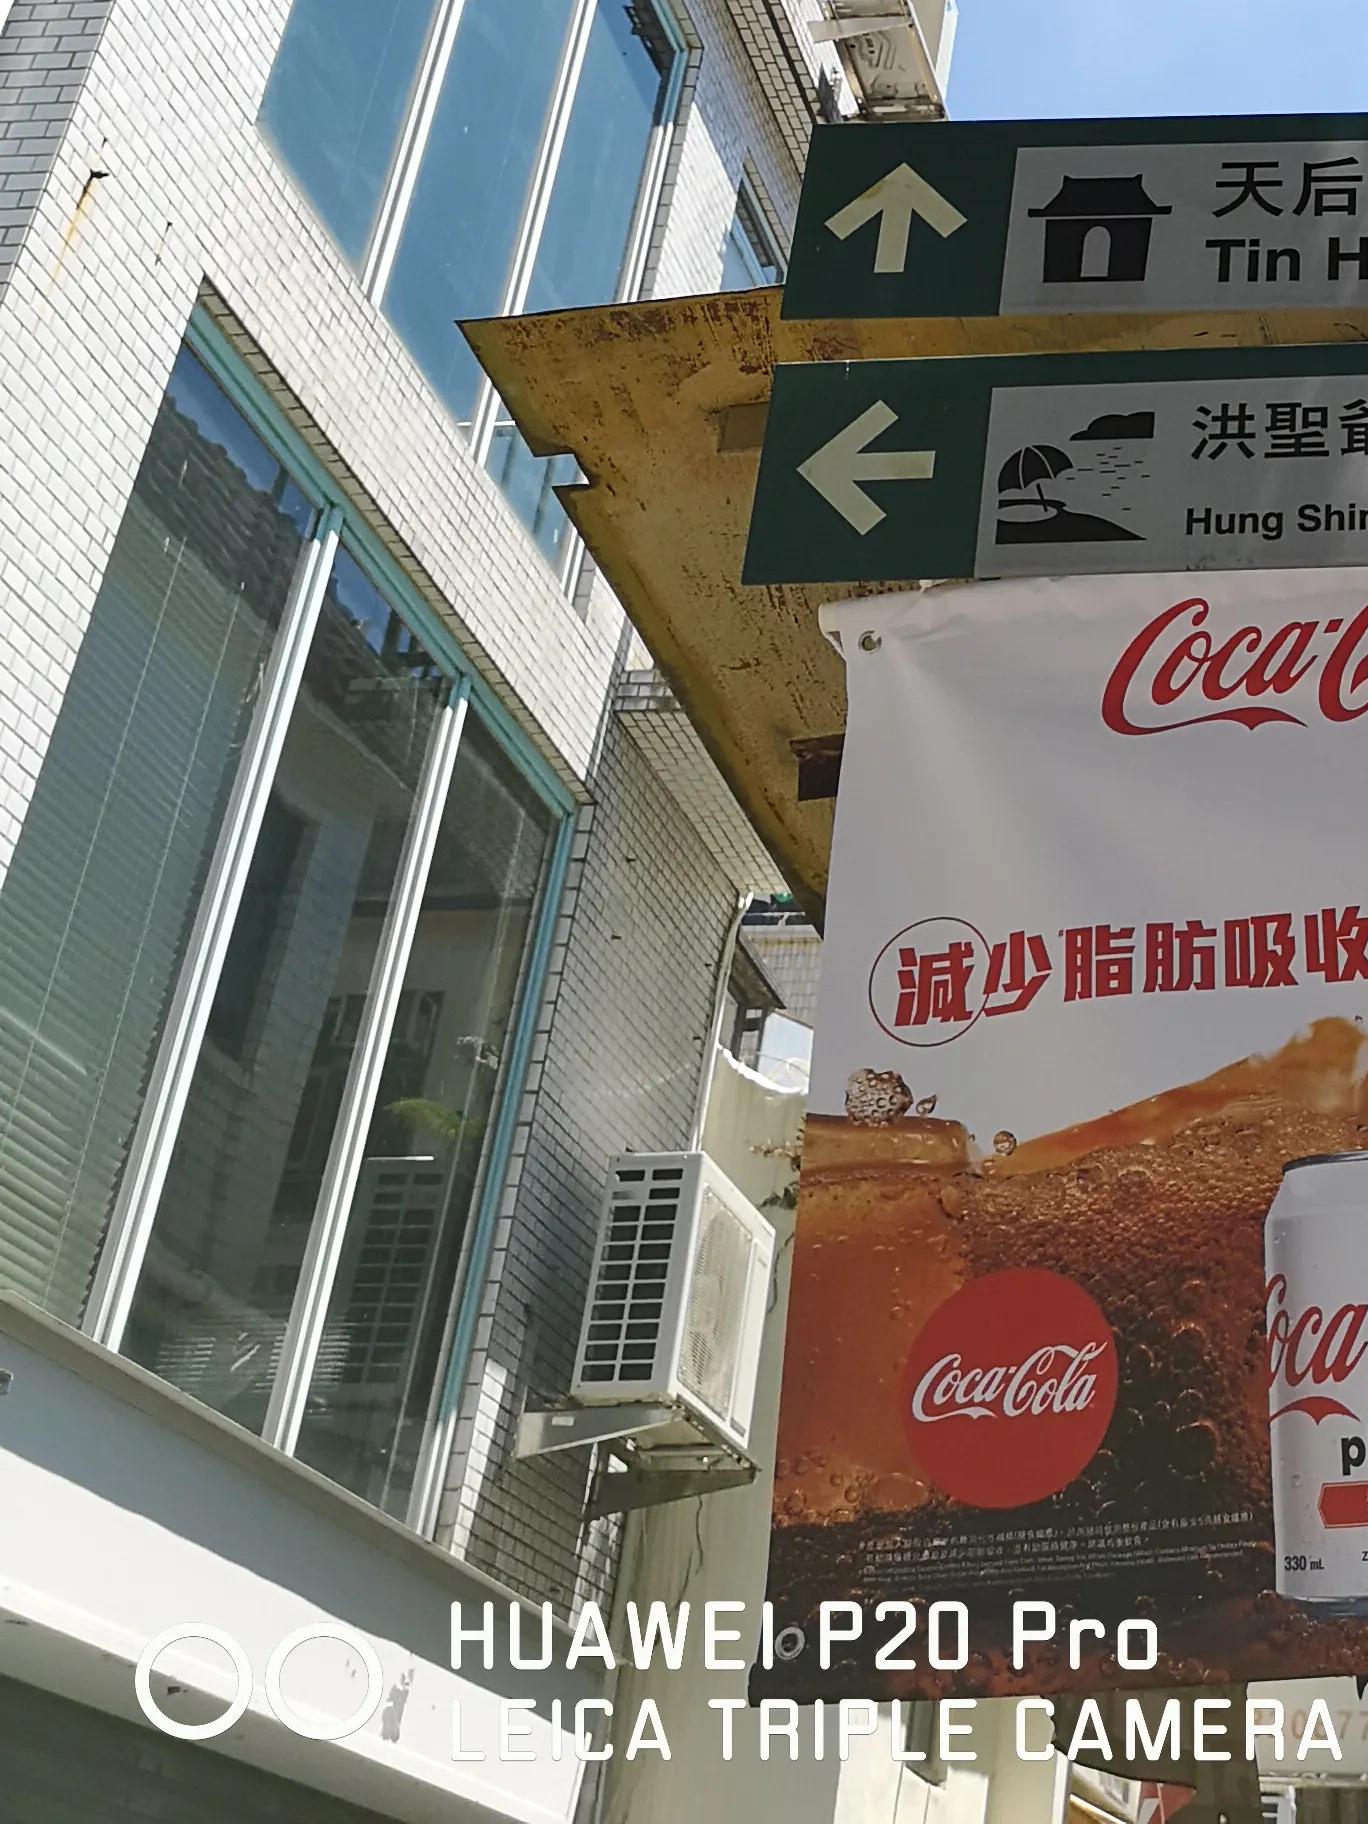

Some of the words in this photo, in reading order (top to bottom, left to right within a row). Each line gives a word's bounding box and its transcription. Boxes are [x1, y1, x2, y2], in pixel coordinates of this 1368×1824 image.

[1204, 239, 1301, 283] Tin
[1185, 507, 1284, 541] Hung
[911, 1340, 1107, 1423] Coca-Cola
[1284, 1555, 1307, 1571] 330
